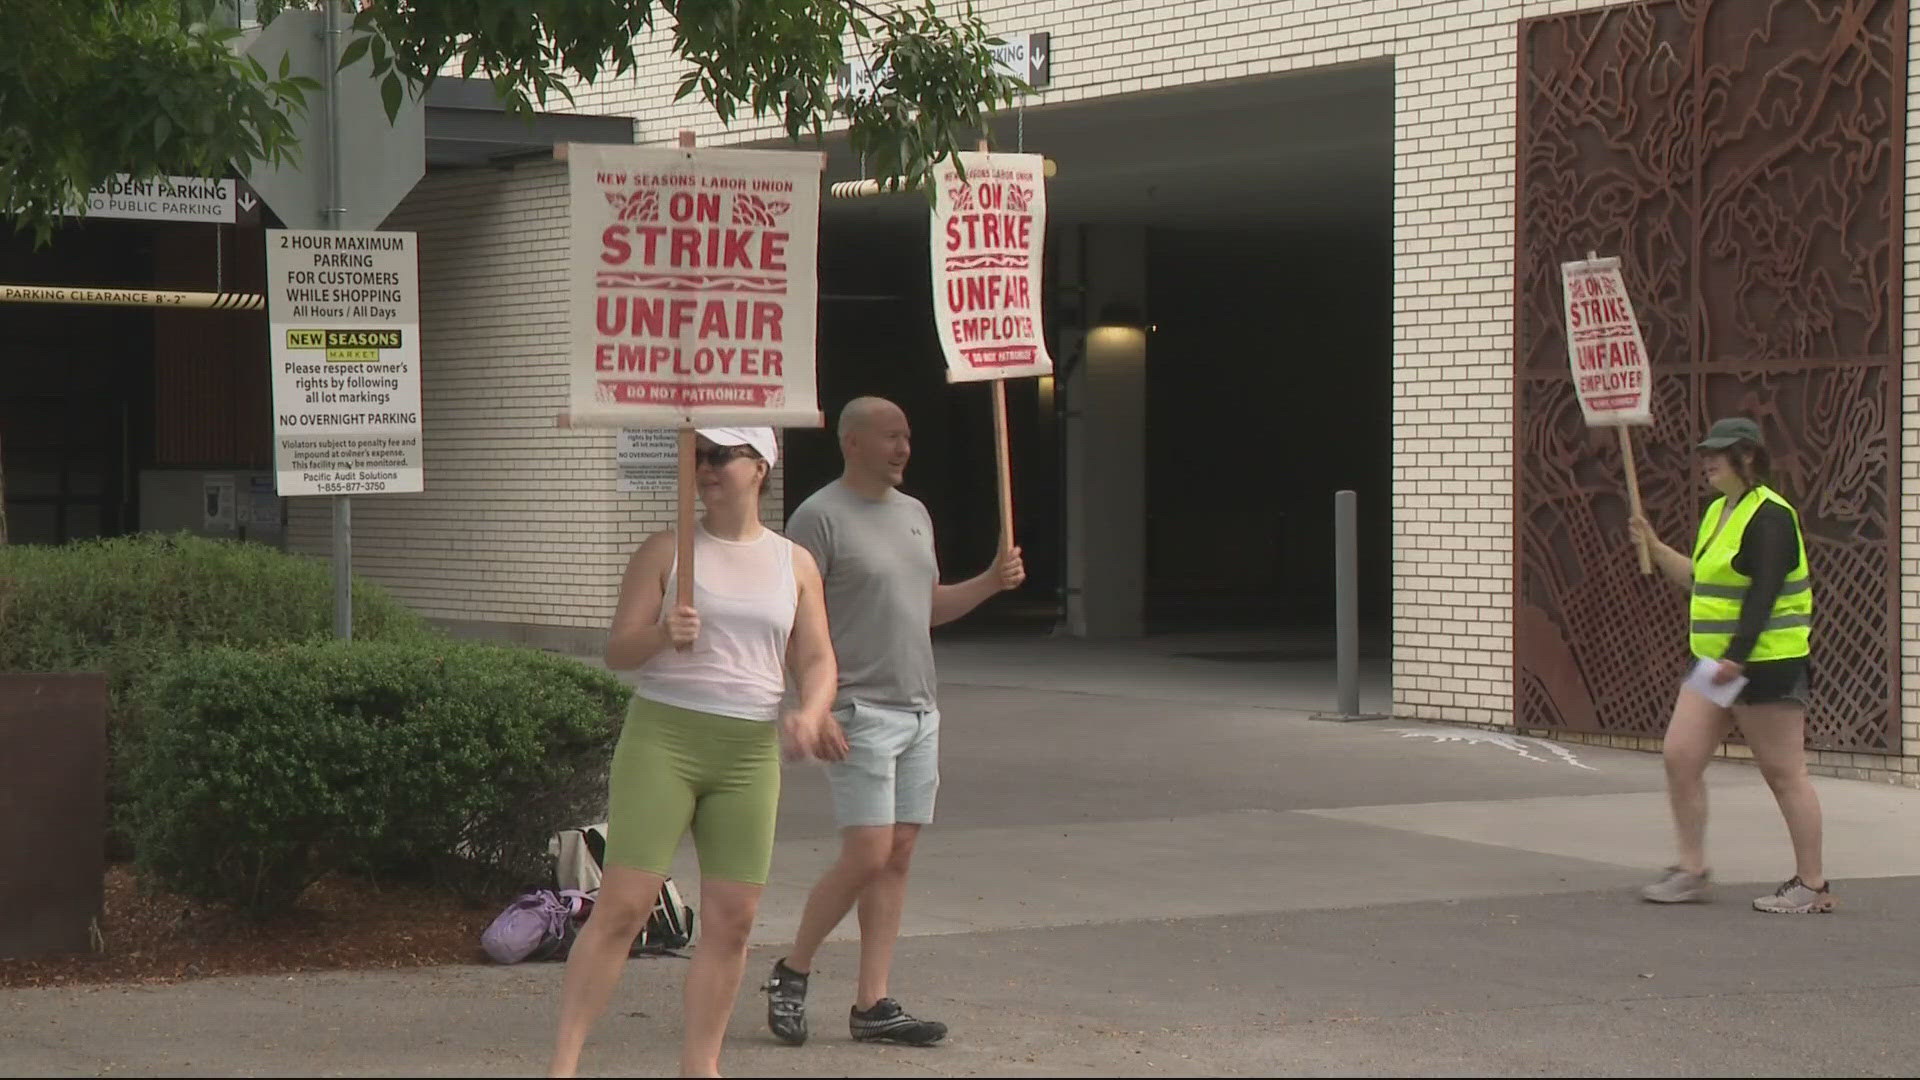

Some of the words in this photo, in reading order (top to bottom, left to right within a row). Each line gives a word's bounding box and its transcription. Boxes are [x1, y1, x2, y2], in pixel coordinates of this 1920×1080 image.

[597, 172, 627, 185] NEW
[634, 174, 696, 187] SEASONS
[701, 177, 747, 191] LABOR
[752, 178, 793, 192] UNION
[158, 183, 227, 200] PARKING
[978, 183, 1003, 210] ON
[110, 200, 157, 213] PUBLIC
[162, 203, 222, 216] PARKING
[669, 191, 721, 223] ON
[946, 213, 1032, 252] STRIKE
[281, 236, 288, 248] 2
[292, 236, 331, 249] HOUR
[335, 237, 404, 251] MAXIMUM
[600, 224, 789, 272] STRIKE
[314, 254, 373, 267] PARKING
[288, 271, 315, 284] FOR
[318, 272, 399, 285] CUSTOMERS
[1586, 276, 1603, 297] ON
[6, 288, 65, 301] PARKING
[70, 290, 149, 303] CLEARANCE
[286, 289, 329, 302] WHILE
[333, 290, 402, 303] SHOPPING
[947, 275, 1030, 314] UNFAIR
[293, 306, 308, 317] All
[311, 306, 344, 318] Hours
[353, 306, 368, 318] All
[370, 306, 397, 320] Days
[596, 296, 784, 342] UNFAIR
[1570, 297, 1630, 328] STRIKE
[951, 315, 1035, 345] EMPLOYER
[289, 333, 323, 346] NEW
[328, 333, 399, 346] SEASONS
[329, 351, 375, 359] MARKET
[595, 344, 784, 377] EMPLOYER
[1576, 340, 1641, 371] UNFAIR
[285, 362, 321, 374] Please
[323, 363, 364, 376] respect
[366, 362, 408, 374] owner's
[295, 378, 328, 391] rights
[331, 378, 345, 391] by
[347, 377, 399, 390] following
[1580, 371, 1642, 394] EMPLOYER
[305, 392, 319, 403] all
[322, 392, 337, 403] lot
[339, 391, 390, 404] markings
[627, 385, 646, 399] DO
[650, 386, 676, 400] NOT
[682, 387, 754, 401] PATRONIZE
[280, 414, 297, 426] NO
[300, 413, 366, 426] OVERNIGHT
[368, 412, 417, 425] PARKING
[282, 440, 317, 450] Violators
[319, 439, 347, 450] subject
[348, 439, 357, 447] to
[358, 439, 387, 450] penalty
[388, 438, 400, 446] fee
[401, 438, 416, 446] and
[331, 450, 339, 458] at
[371, 450, 405, 460] expense.
[291, 461, 308, 470] This
[309, 460, 336, 470] facility
[337, 461, 353, 470] may
[354, 459, 364, 468] be
[366, 458, 408, 468] monitored.
[303, 472, 331, 482] Pacific
[334, 471, 356, 481] Audit
[359, 470, 398, 481] Solutions
[317, 481, 385, 493] 1-855-877-3750
